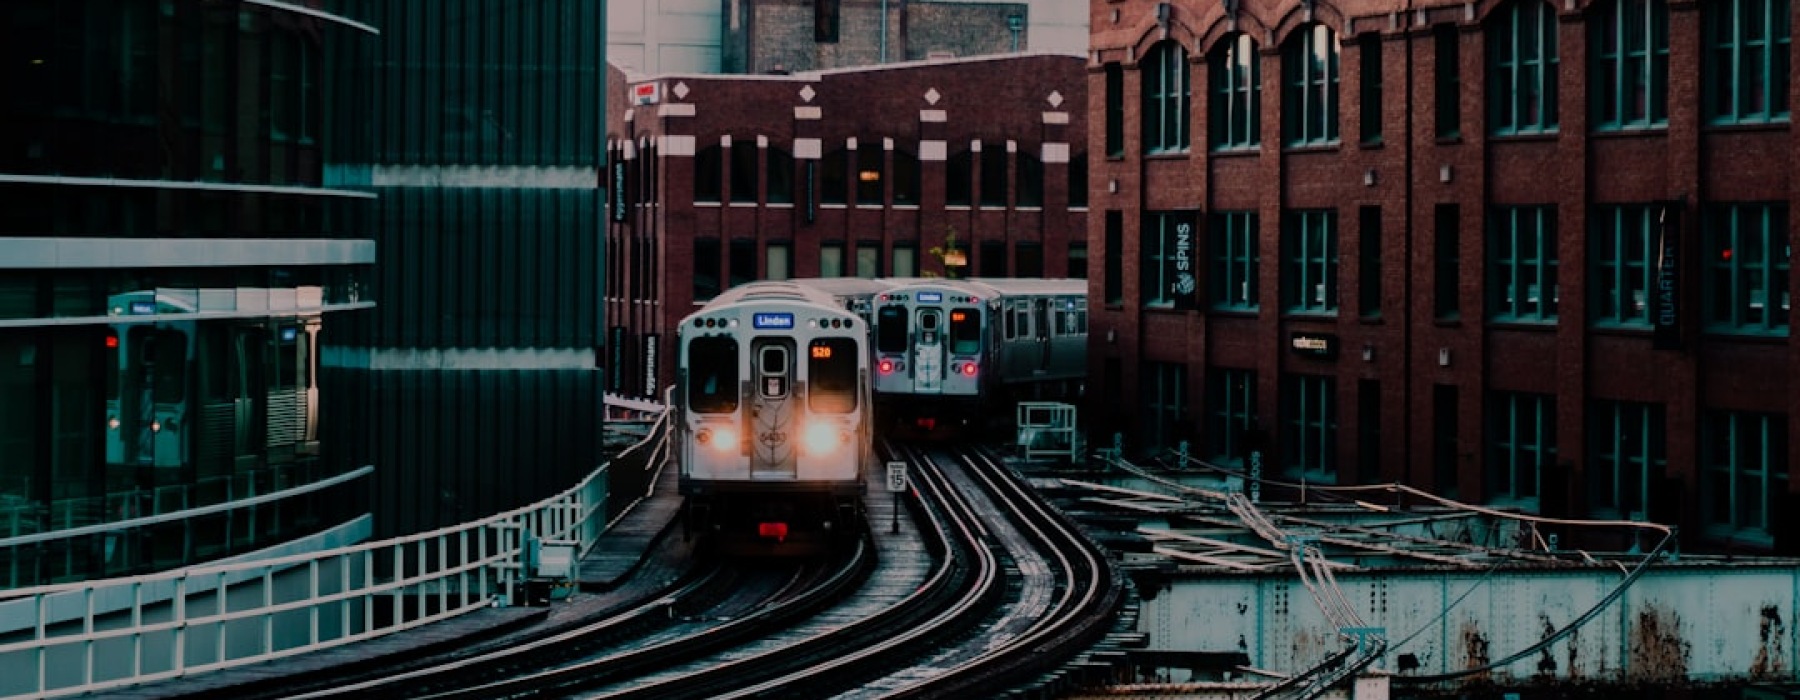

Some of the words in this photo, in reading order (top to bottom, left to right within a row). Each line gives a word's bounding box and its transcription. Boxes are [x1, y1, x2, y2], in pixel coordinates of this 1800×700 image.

[1176, 222, 1190, 271] SPINS
[759, 315, 791, 326] Linden
[645, 335, 655, 395] eggersmann
[890, 475, 903, 486] 15
